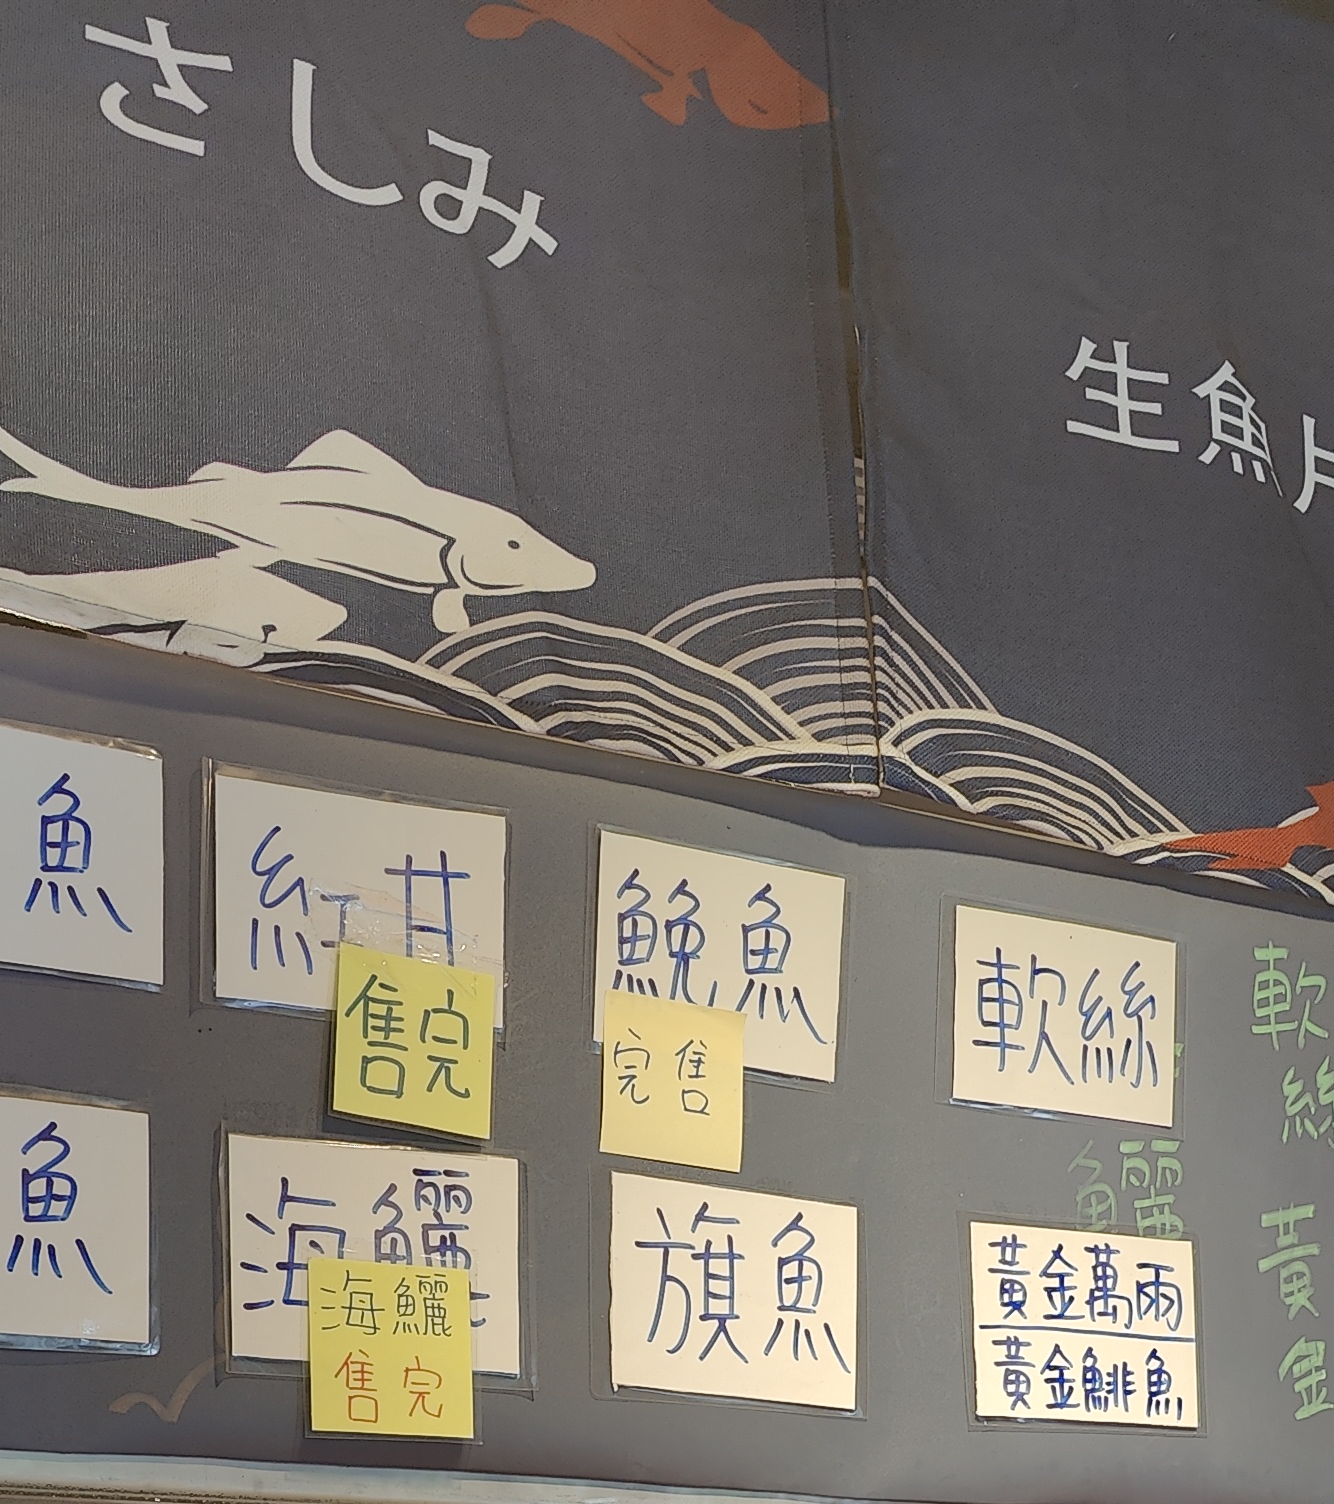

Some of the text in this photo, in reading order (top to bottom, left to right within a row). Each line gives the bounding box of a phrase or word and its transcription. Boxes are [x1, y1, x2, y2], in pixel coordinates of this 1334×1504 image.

[84, 17, 558, 268] さしみ
[251, 826, 470, 974] 紅甘
[344, 974, 470, 1099] 售完
[612, 1027, 711, 1116] 完售
[972, 946, 1158, 1088] 軟絲
[319, 1270, 455, 1338] 海鱺
[635, 1202, 851, 1373] 旗魚
[334, 1348, 445, 1424] 售完
[992, 1335, 1183, 1420] 黃金鯡魚
